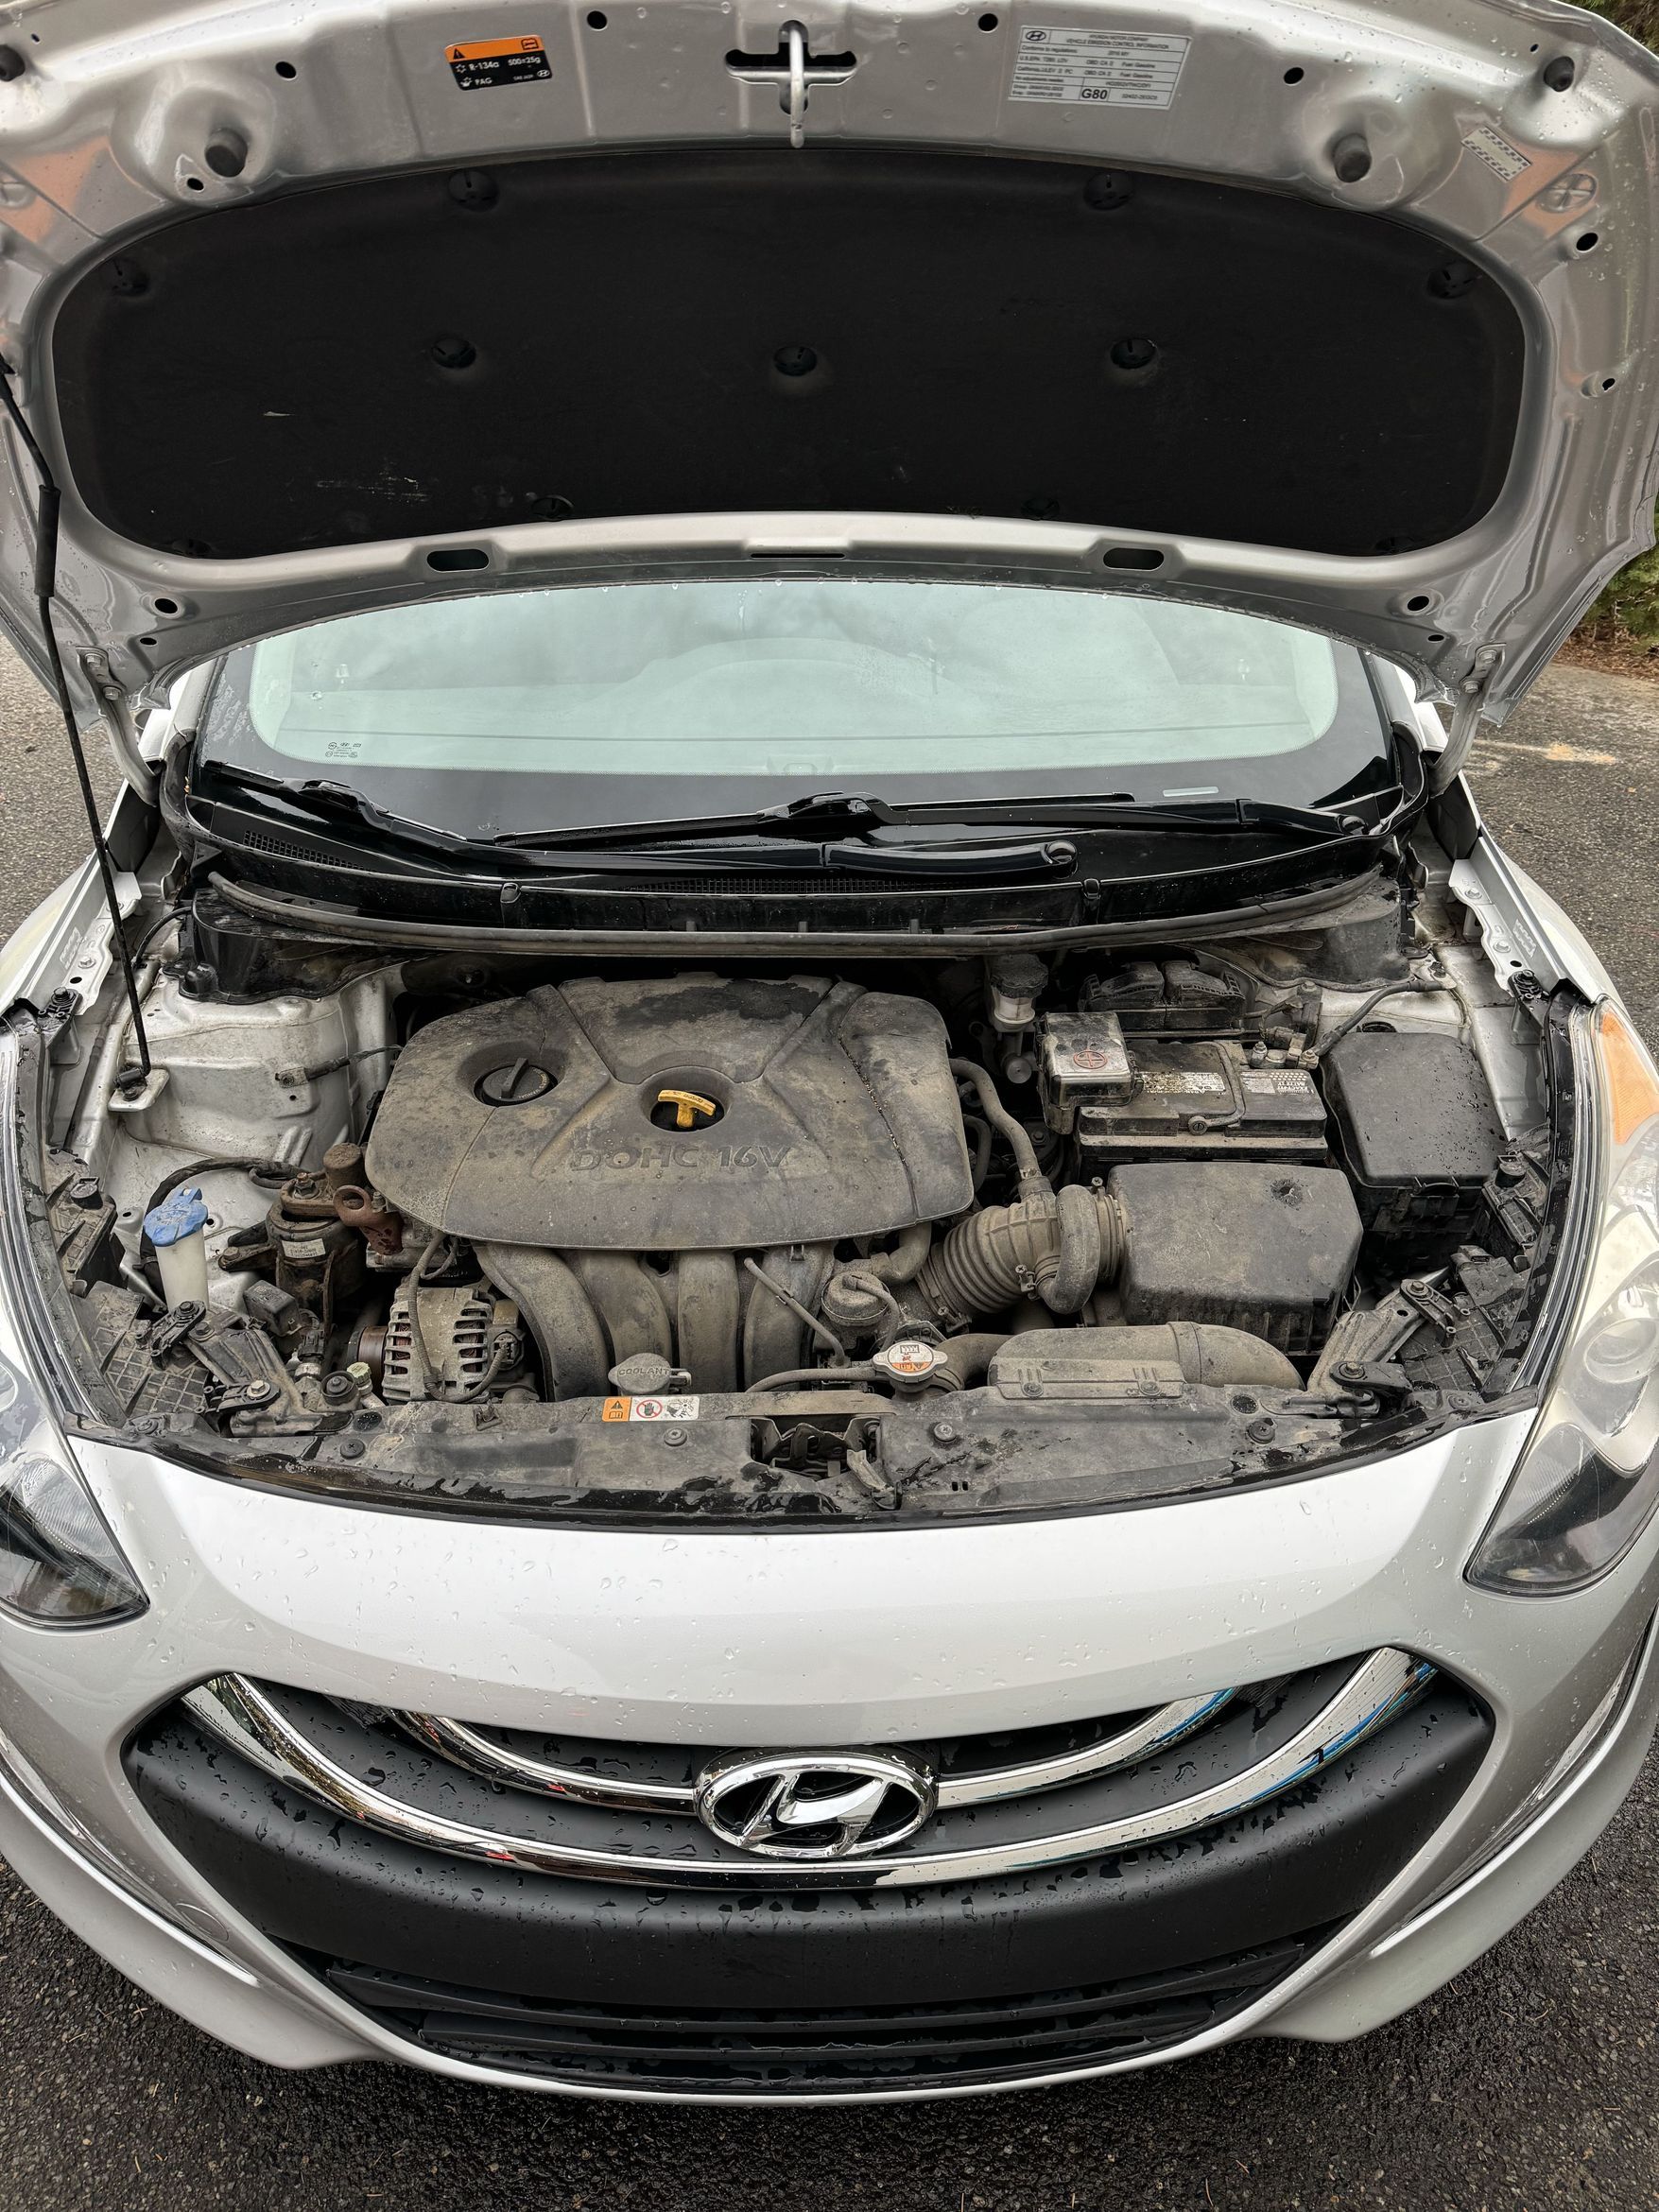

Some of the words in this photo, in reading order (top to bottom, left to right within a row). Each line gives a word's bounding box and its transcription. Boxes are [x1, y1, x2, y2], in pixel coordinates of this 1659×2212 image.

[469, 61, 500, 71] R-134a
[475, 78, 493, 86] PAG
[1081, 88, 1108, 99] G80
[570, 1145, 699, 1171] DOHC
[717, 1145, 791, 1168] 16V
[618, 1367, 670, 1375] COOLANT
